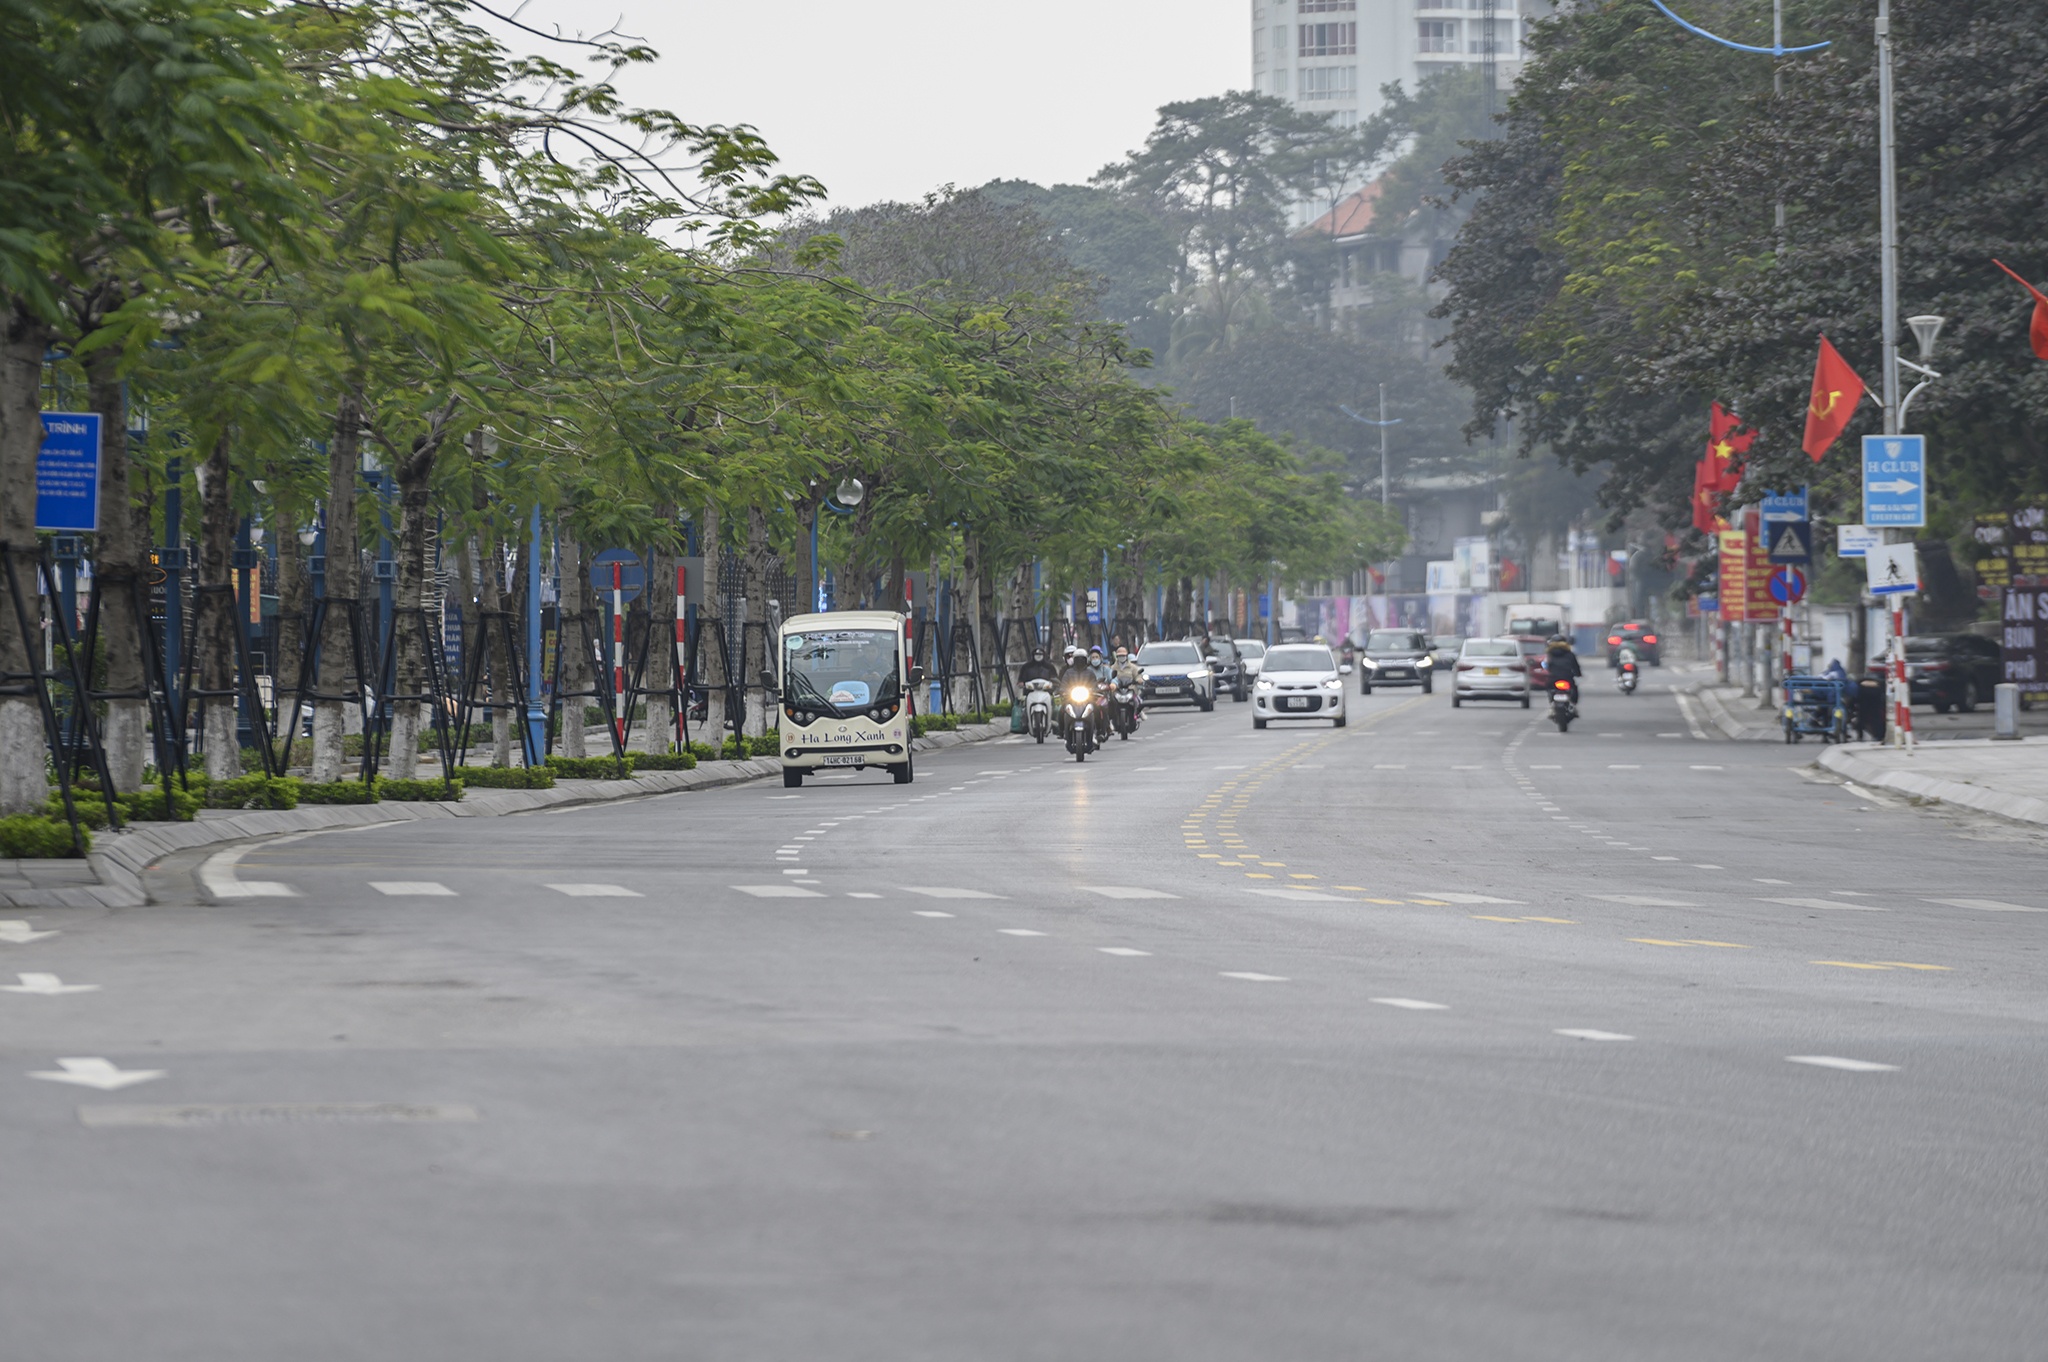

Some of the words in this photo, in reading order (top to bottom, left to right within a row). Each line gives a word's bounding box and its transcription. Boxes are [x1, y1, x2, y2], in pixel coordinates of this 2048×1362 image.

[47, 420, 87, 435] TRÌNH
[1868, 461, 1879, 473] H
[1881, 461, 1919, 473] CLUB
[1774, 496, 1804, 506] CLUB
[2004, 588, 2034, 620] ĂN
[2004, 623, 2036, 649] BÚN
[2004, 655, 2036, 679] PHỞ
[801, 734, 819, 744] Ha
[824, 733, 852, 744] Long
[855, 730, 885, 743] Xanh
